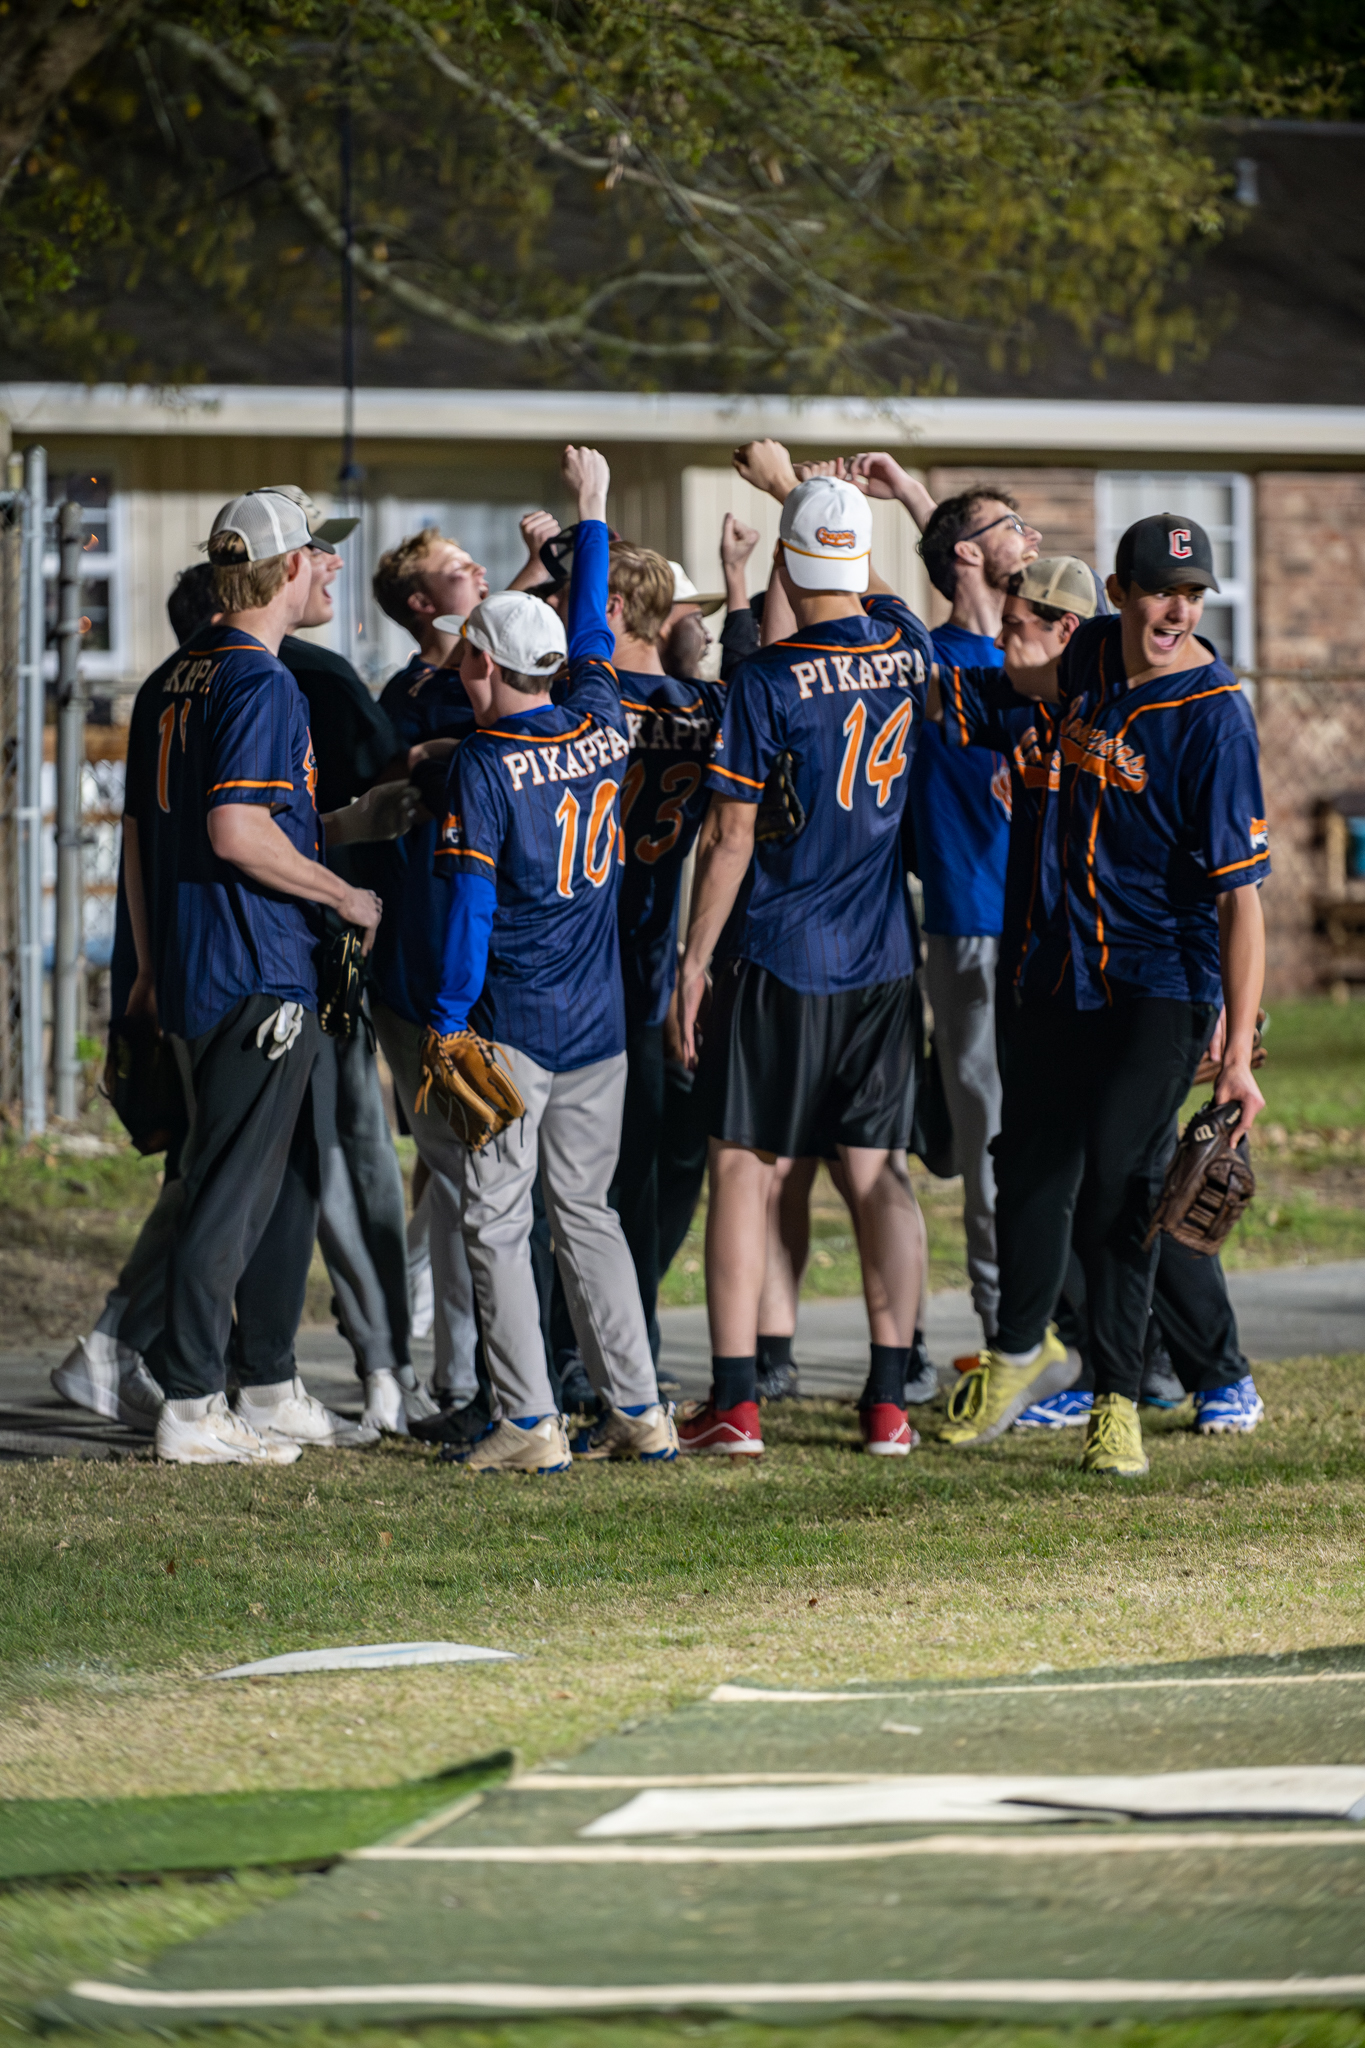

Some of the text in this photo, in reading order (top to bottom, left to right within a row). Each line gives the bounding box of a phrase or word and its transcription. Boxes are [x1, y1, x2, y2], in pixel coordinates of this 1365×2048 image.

[1168, 528, 1193, 560] C
[836, 697, 913, 812] 14
[555, 778, 620, 899] 10
[618, 757, 702, 866] 13
